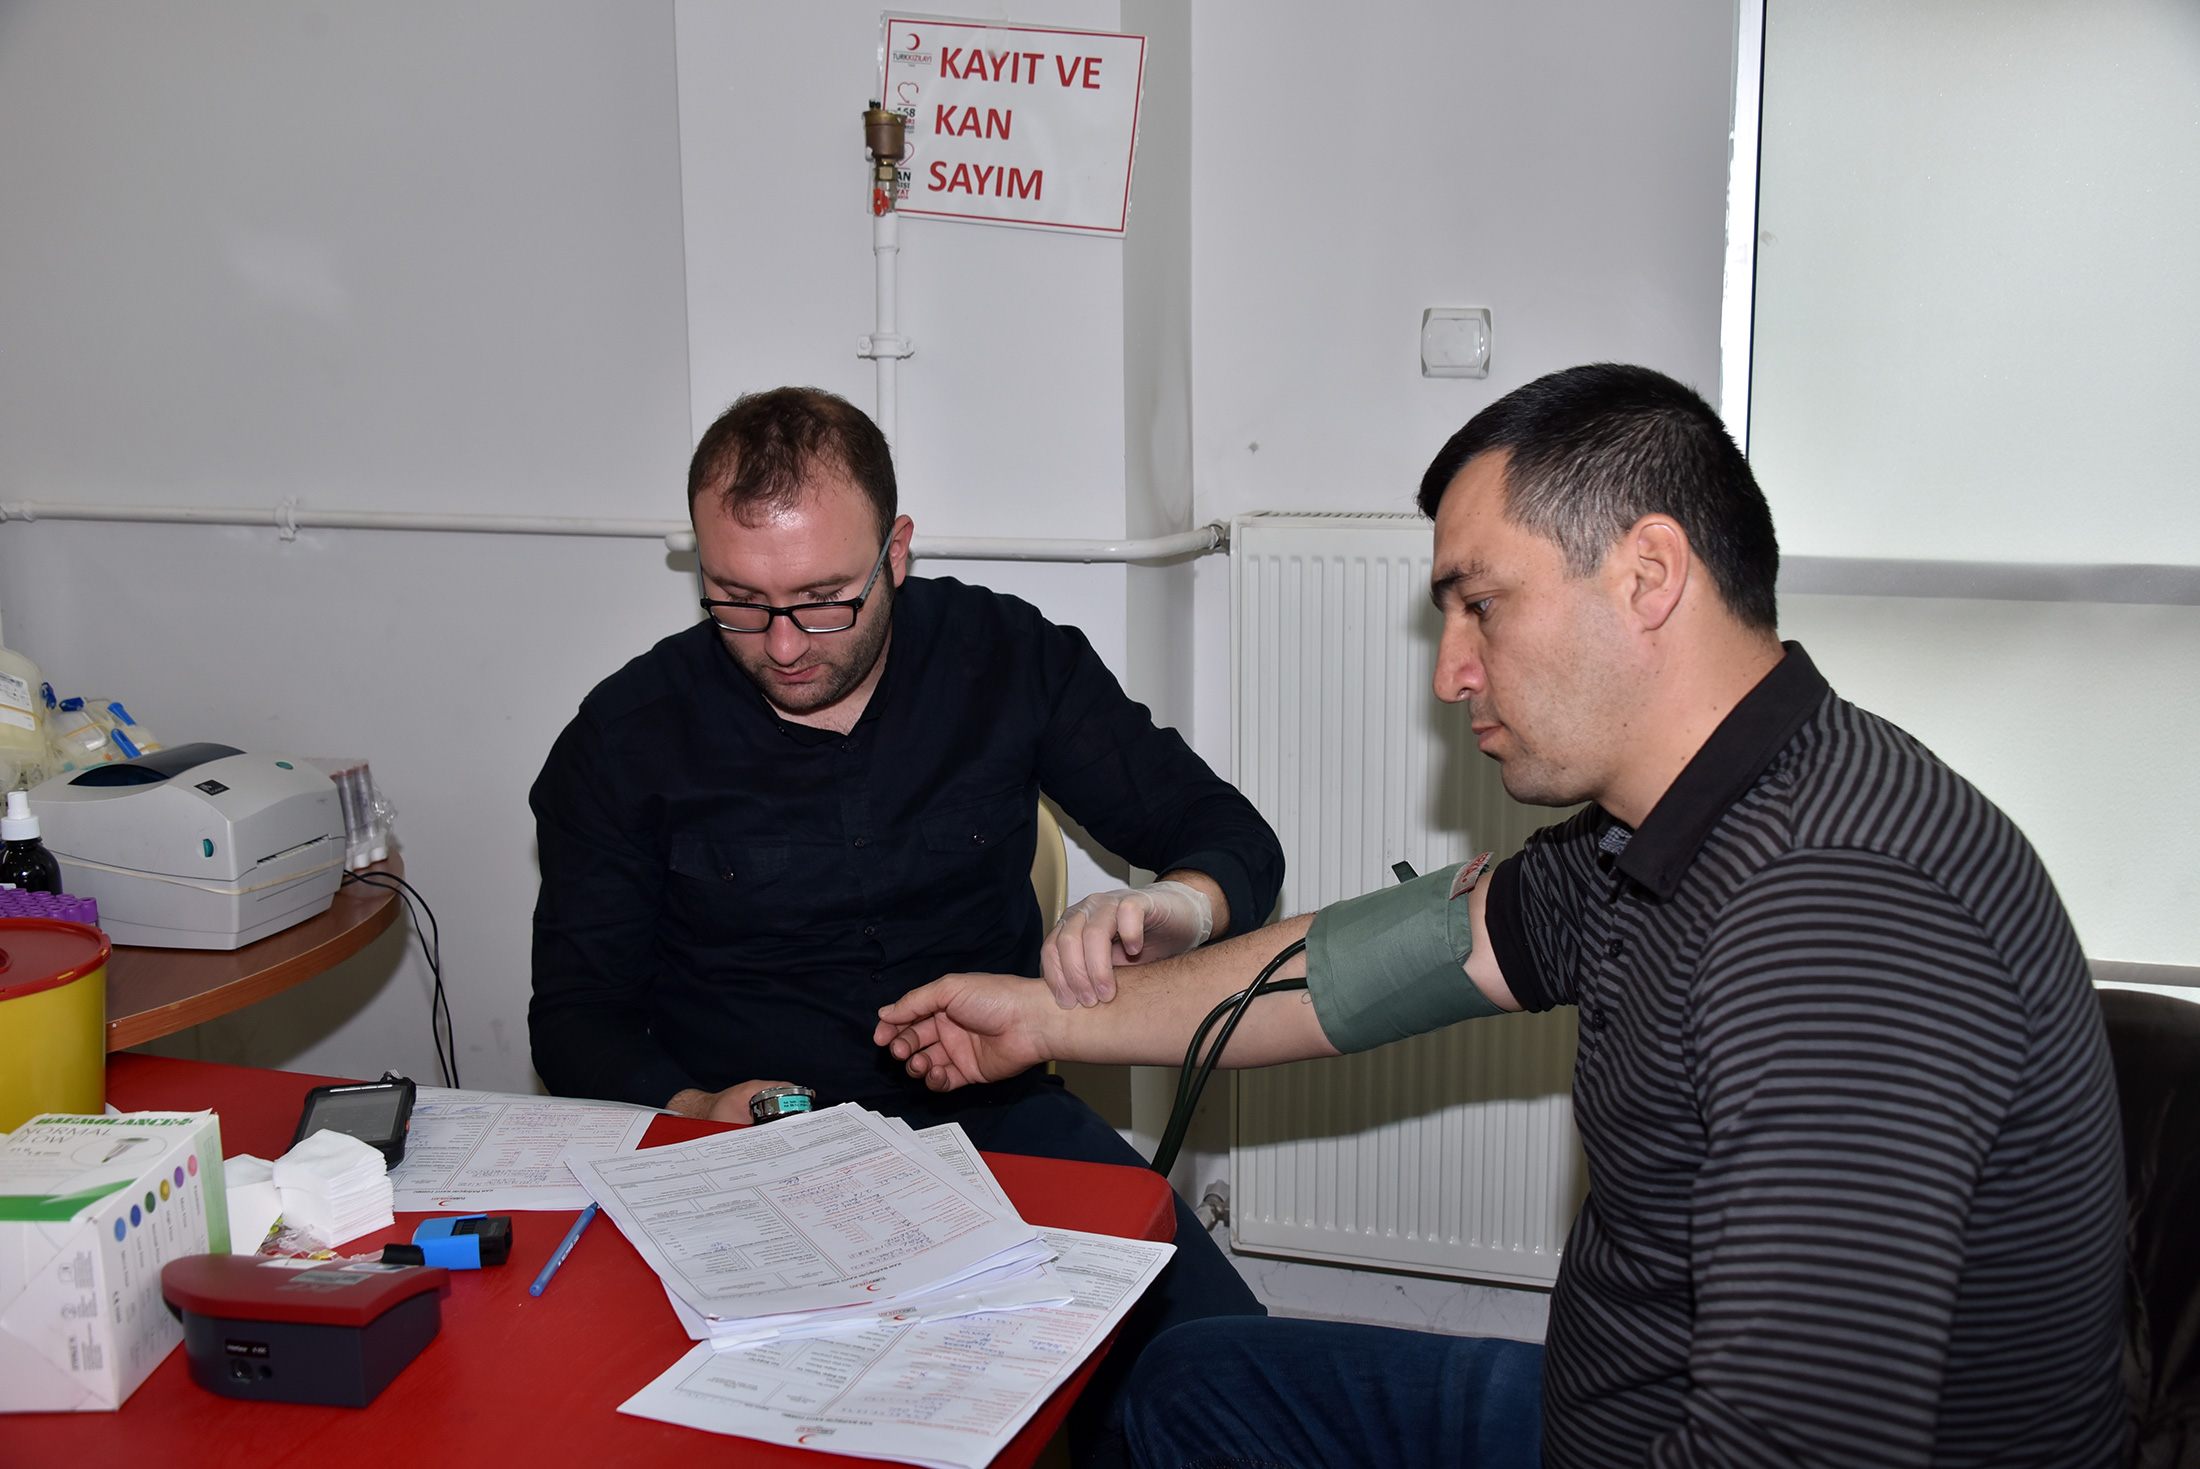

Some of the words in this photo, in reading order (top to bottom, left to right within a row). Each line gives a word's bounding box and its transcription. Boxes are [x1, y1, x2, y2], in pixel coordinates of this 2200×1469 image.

[940, 47, 1045, 85] KAYIT
[1055, 54, 1103, 90] VE
[935, 104, 1012, 141] KAN
[928, 160, 1044, 201] SAYIM
[6, 1134, 73, 1145] FLOW
[18, 1126, 112, 1137] NORMAL
